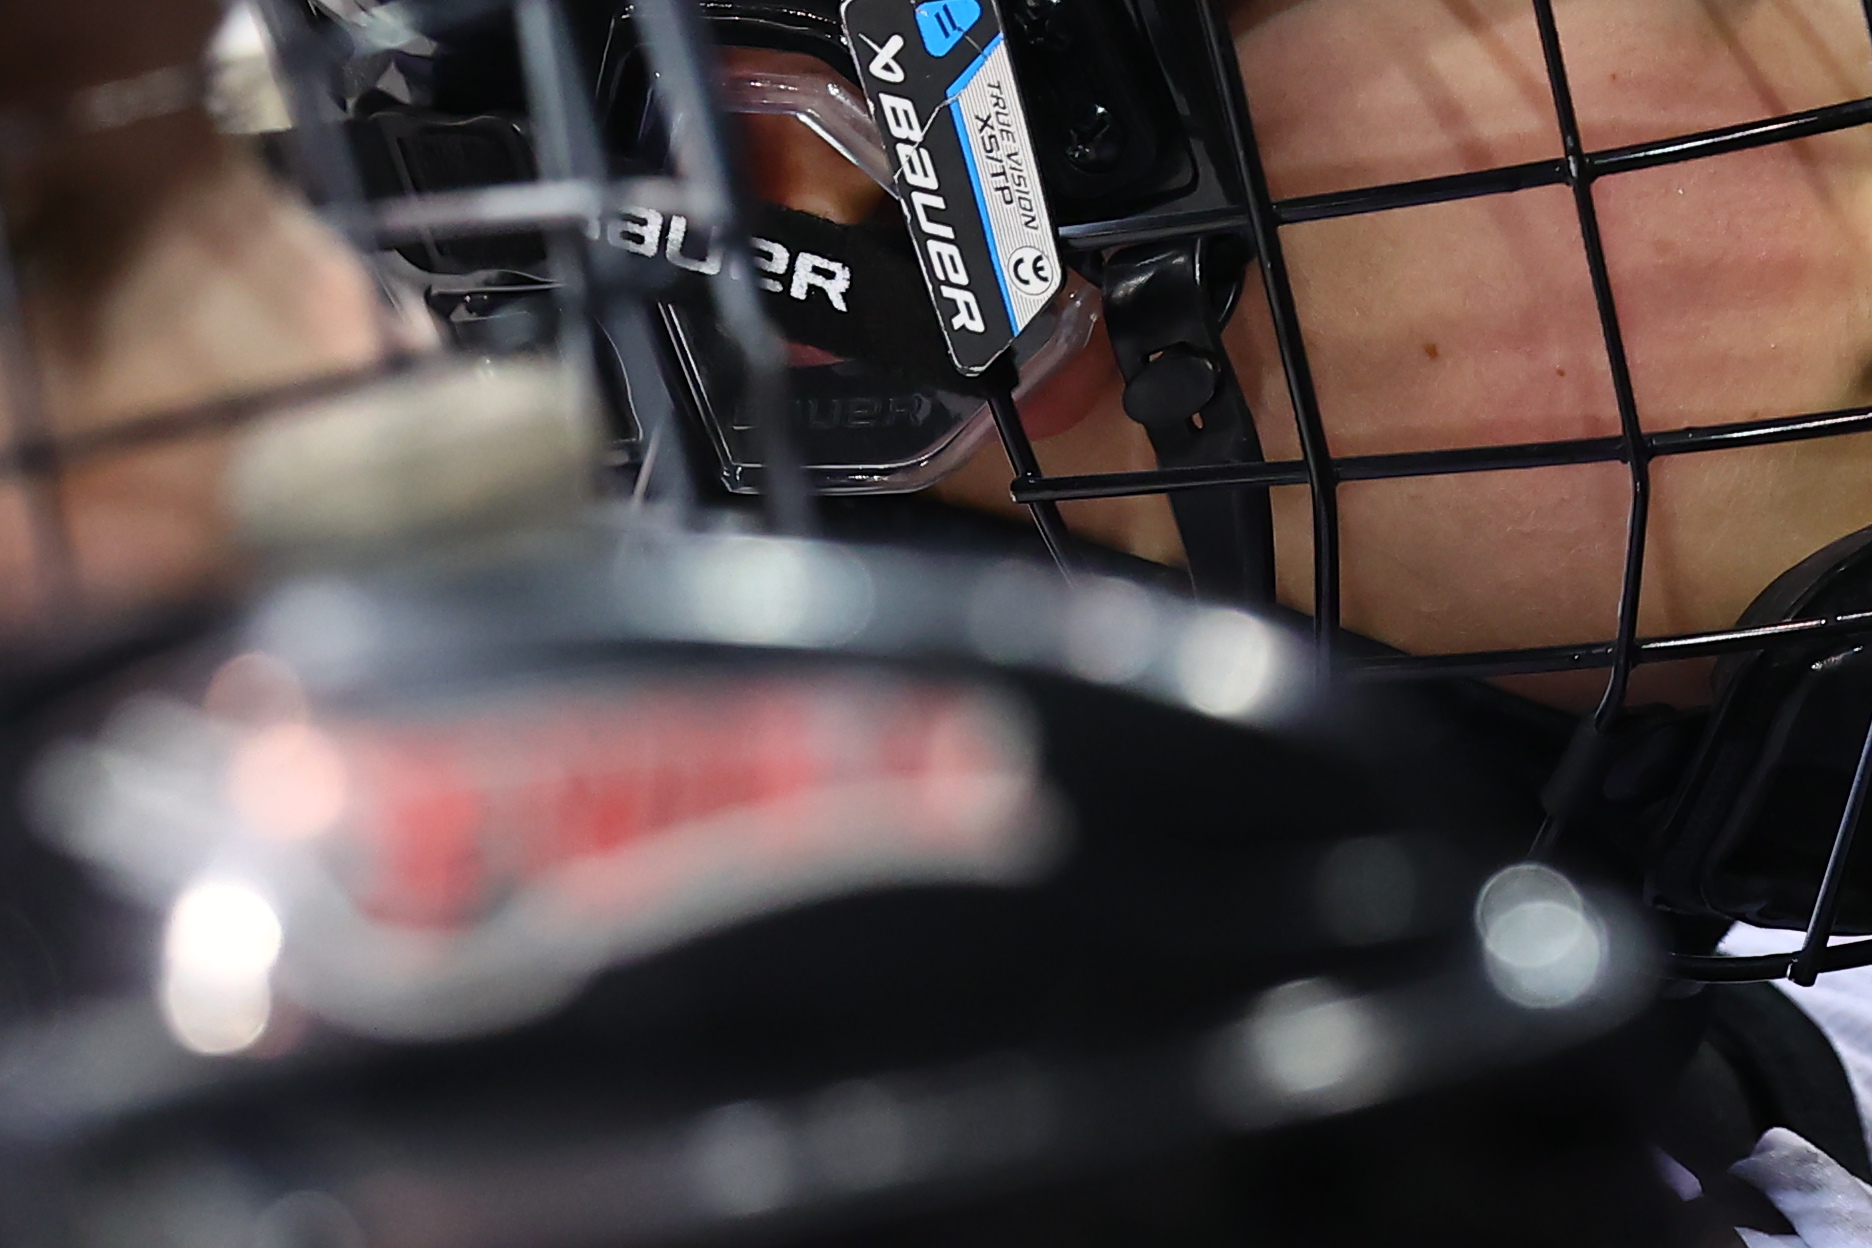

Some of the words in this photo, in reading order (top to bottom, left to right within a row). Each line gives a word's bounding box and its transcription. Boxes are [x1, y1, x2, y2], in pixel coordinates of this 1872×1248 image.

[879, 91, 986, 335] BAUER
[974, 114, 1013, 206] XS/TP
[986, 79, 1016, 153] TRUE
[1008, 153, 1040, 232] VISION
[580, 202, 852, 313] AUER
